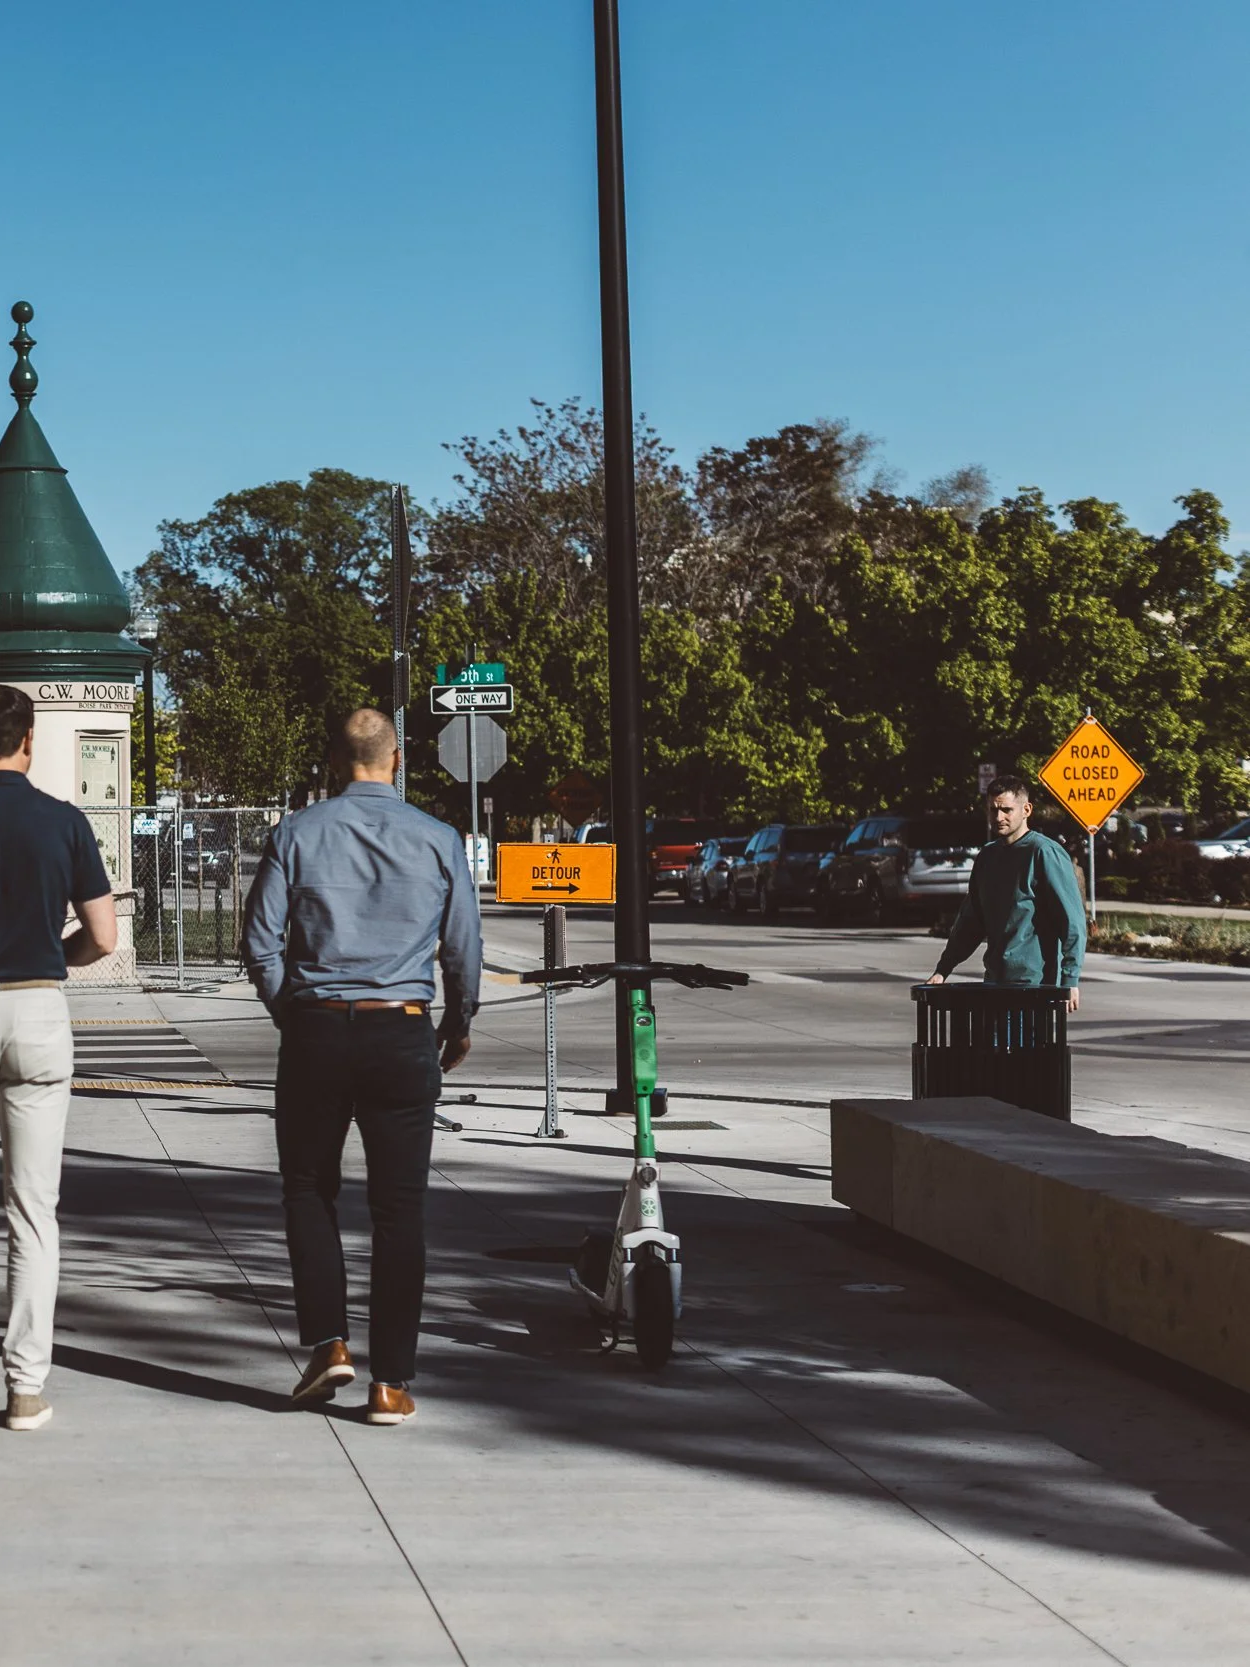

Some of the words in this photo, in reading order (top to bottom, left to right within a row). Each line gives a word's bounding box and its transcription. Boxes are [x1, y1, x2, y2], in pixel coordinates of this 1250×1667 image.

[38, 684, 73, 700] C.W.
[83, 684, 130, 700] MOORE
[455, 694, 477, 704] ONE
[481, 693, 503, 704] WAY
[92, 744, 111, 753] MOORE
[1070, 744, 1111, 759] ROAD
[1062, 766, 1119, 780] CLOSED
[1067, 787, 1116, 802] AHEAD
[531, 866, 581, 880] DETOUR
